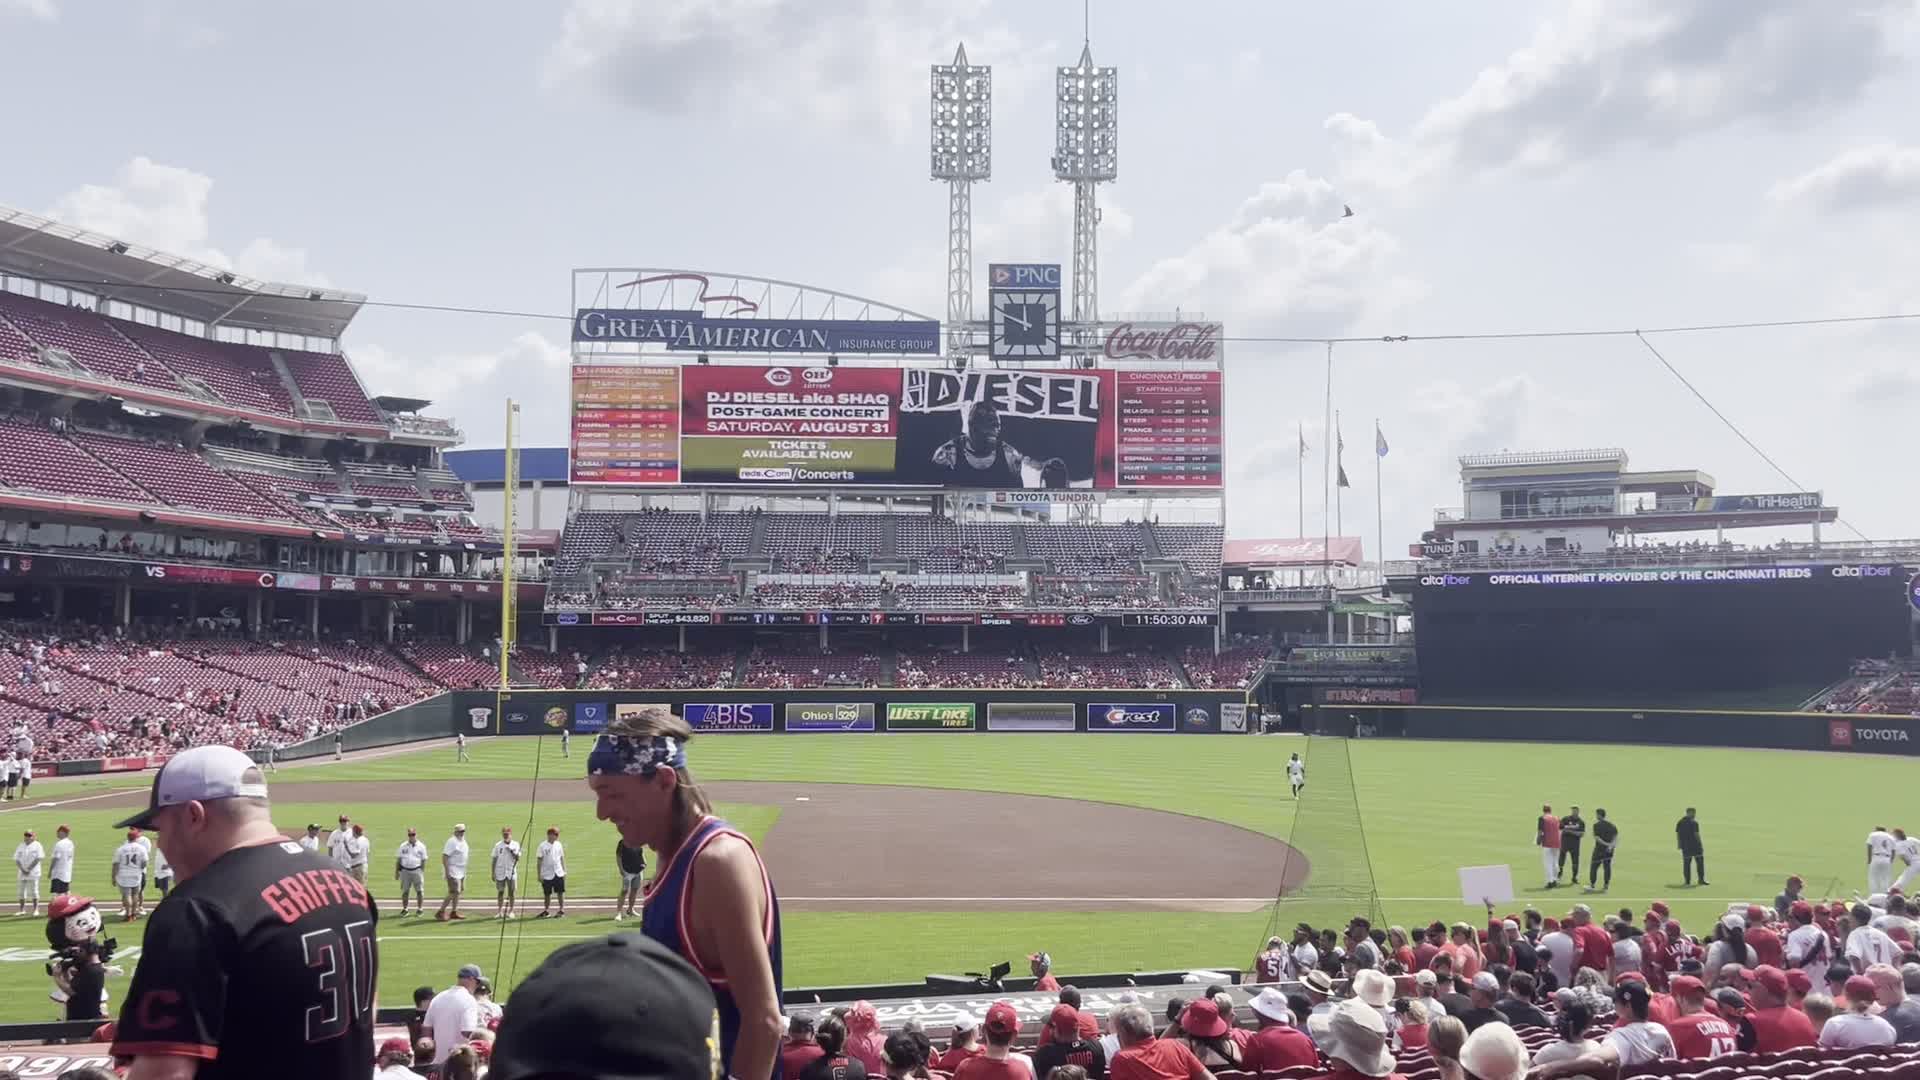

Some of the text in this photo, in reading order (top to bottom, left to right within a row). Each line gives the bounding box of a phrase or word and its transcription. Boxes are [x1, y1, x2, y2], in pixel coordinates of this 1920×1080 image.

[1015, 267, 1059, 283] PNC
[579, 312, 934, 350] GREAT AMERICAN INSURANCE GROUP
[706, 391, 890, 406] DJ DIESEL aka SHAQ
[711, 407, 884, 418] POST-GAME CONCERT
[706, 421, 890, 434] SATURDAY, AUGUST 31
[768, 440, 827, 450] TICKETS
[742, 450, 853, 460] AVAILABLE NOW
[1010, 493, 1096, 502] TOYOTA TUNDRA
[1754, 495, 1818, 508] TriHealth
[1423, 544, 1466, 554] TUNDA
[145, 565, 166, 578] VS
[1421, 564, 1893, 587] altafiber OFFICIAL INTERNET PROVIDER OF THE CINCINNATI REDS altafiber
[1136, 615, 1208, 625] 11:50:30 AM
[702, 704, 754, 725] 4BIS
[801, 710, 857, 721] Ohio's 529
[889, 707, 968, 721] WEST LAKE
[1106, 709, 1161, 724] Crest
[941, 719, 968, 728] TIRES
[1855, 728, 1909, 741] TOYOTA
[125, 853, 138, 867] 14
[301, 920, 374, 1042] 30
[136, 989, 179, 1031] C
